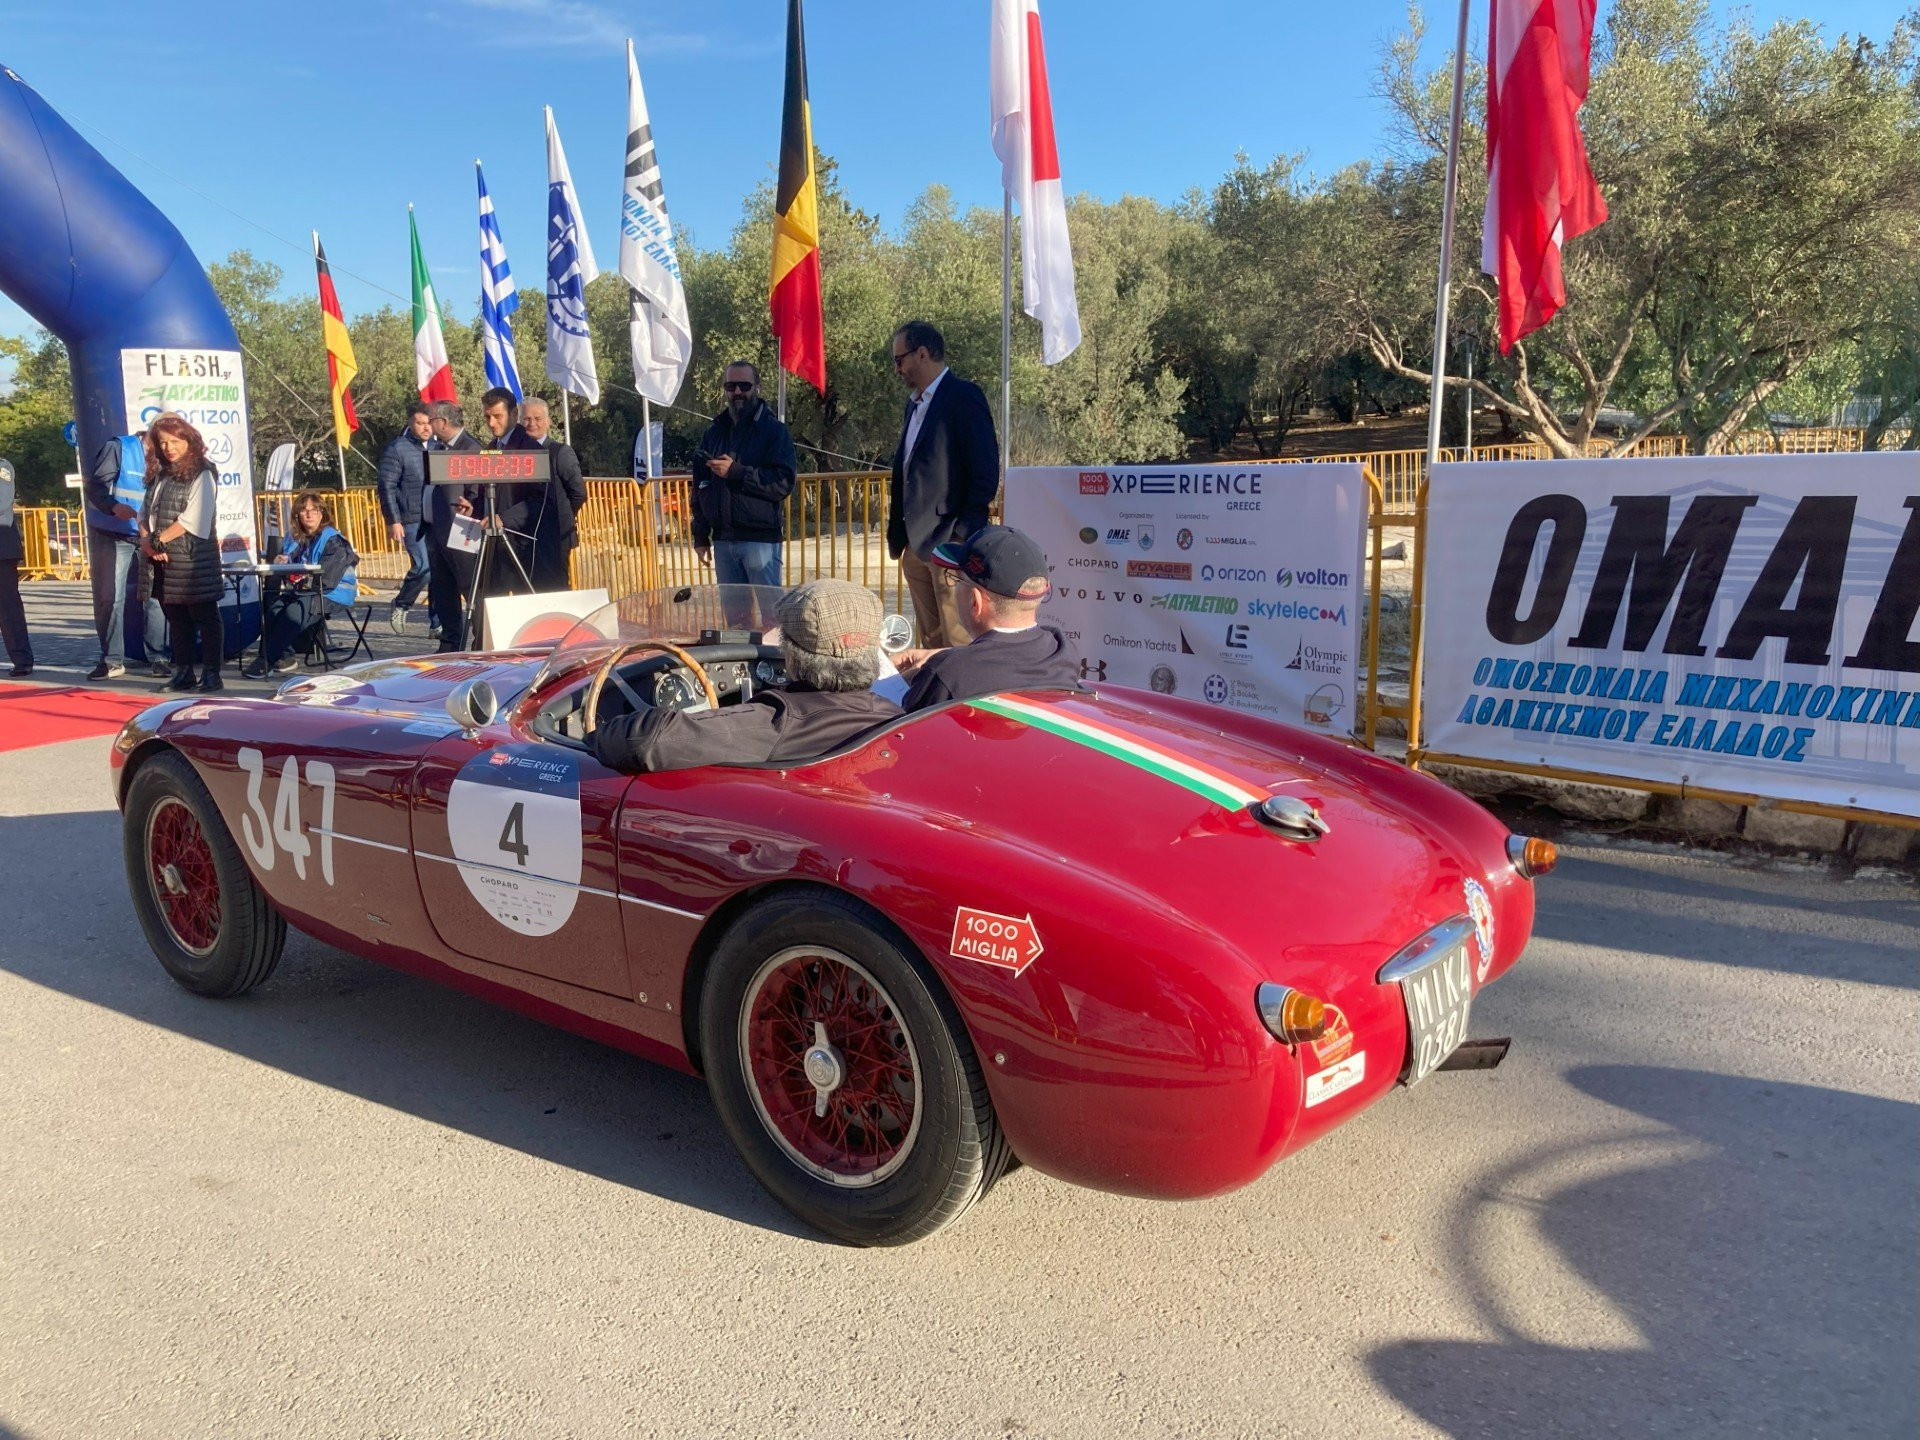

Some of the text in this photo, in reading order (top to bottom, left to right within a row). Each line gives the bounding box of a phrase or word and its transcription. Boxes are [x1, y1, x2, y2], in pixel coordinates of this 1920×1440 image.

[1226, 501, 1261, 511] GREECE
[219, 512, 248, 521] ROZEN
[1119, 512, 1144, 520] Organized
[1068, 558, 1119, 570] CHOPARD
[1128, 562, 1191, 574] VOYAGER
[1218, 568, 1266, 582] orizon
[1296, 568, 1348, 587] volton
[1058, 588, 1143, 603] VOLVO
[1167, 593, 1239, 615] ATHLETIKO
[1144, 639, 1177, 653] Yachts
[1304, 646, 1348, 666] Olympic
[1304, 659, 1342, 674] Marine
[1472, 657, 1669, 704] ΟΜΟΣΠΟΝΔΙΑ
[1456, 694, 1816, 763] ΑΘΛΗΤΙΣΜΟΥ ΕΛΛΑΔΟΣ
[538, 773, 563, 783] GREECE
[238, 747, 335, 886] 347
[499, 802, 529, 866] 4
[966, 916, 1018, 940] 1000
[958, 937, 1018, 963] MIGLIA
